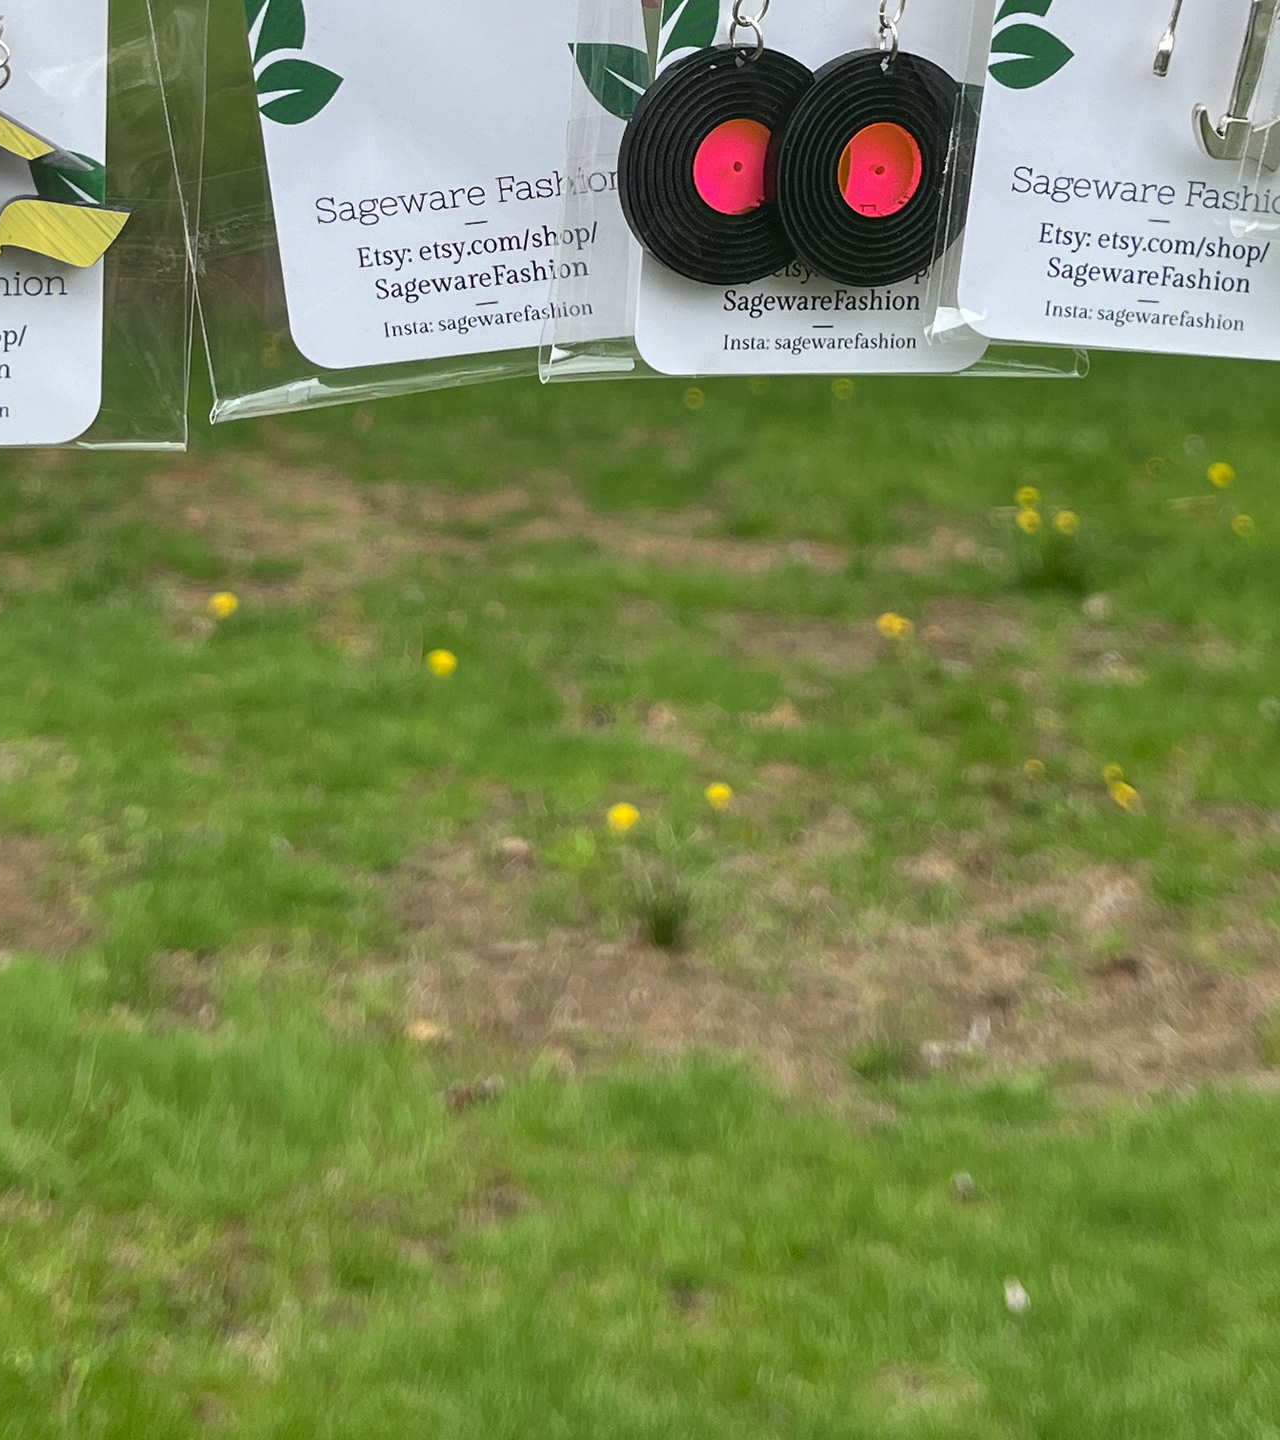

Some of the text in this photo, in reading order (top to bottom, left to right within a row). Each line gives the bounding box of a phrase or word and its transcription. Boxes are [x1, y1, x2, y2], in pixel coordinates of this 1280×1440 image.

[1011, 166, 1175, 205] Sageware
[315, 185, 486, 226] Sageware
[357, 221, 598, 272] Etsy: etsy.com/shop/
[1038, 222, 1271, 267] Etsy: etsy.com/shop/
[375, 258, 590, 304] SagewareFashion
[1047, 257, 1251, 294] SagewareFashion
[384, 300, 593, 338] Insta: sagewarefashion
[723, 290, 920, 318] SagewareFashion
[1044, 300, 1245, 332] Insta: sagewarefashion
[723, 333, 917, 355] Insta: sagewarefashion
